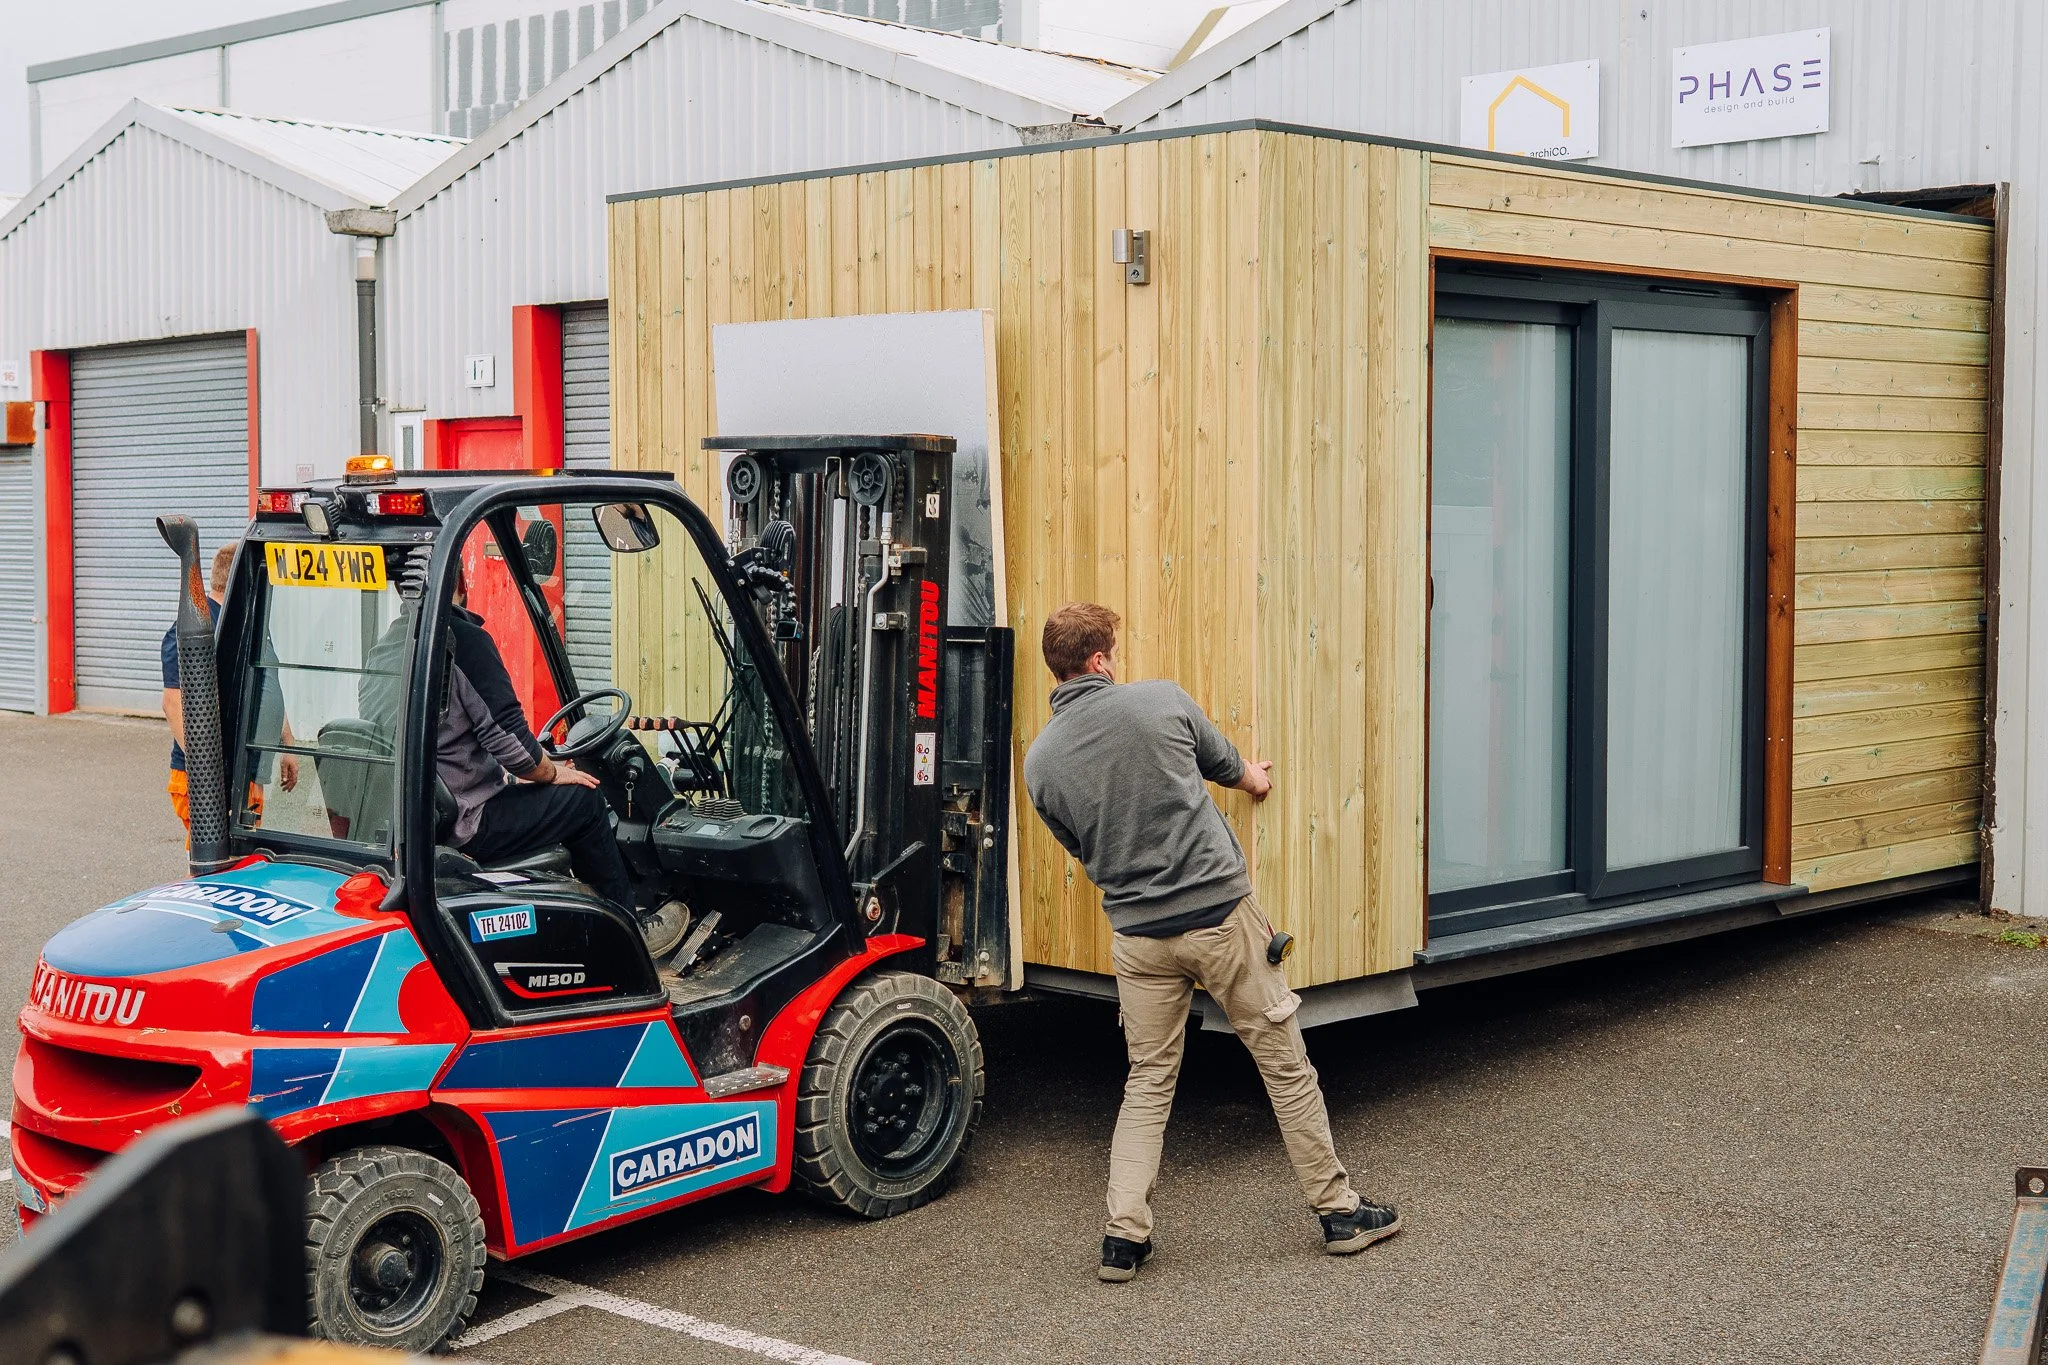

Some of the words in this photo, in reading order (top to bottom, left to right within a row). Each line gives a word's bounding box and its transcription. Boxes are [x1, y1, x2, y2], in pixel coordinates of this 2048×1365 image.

[1679, 59, 1821, 104] PHASE
[1704, 103, 1739, 114] design
[1743, 100, 1763, 110] and
[1768, 96, 1795, 107] build
[274, 548, 329, 581] WJ24
[333, 550, 377, 584] YWR
[917, 580, 940, 720] MANITOU
[148, 883, 303, 922] CARADON
[481, 917, 497, 935] TFL
[499, 912, 529, 932] 24102
[31, 962, 146, 1025] MANITOU
[616, 1122, 755, 1187] CARADON
